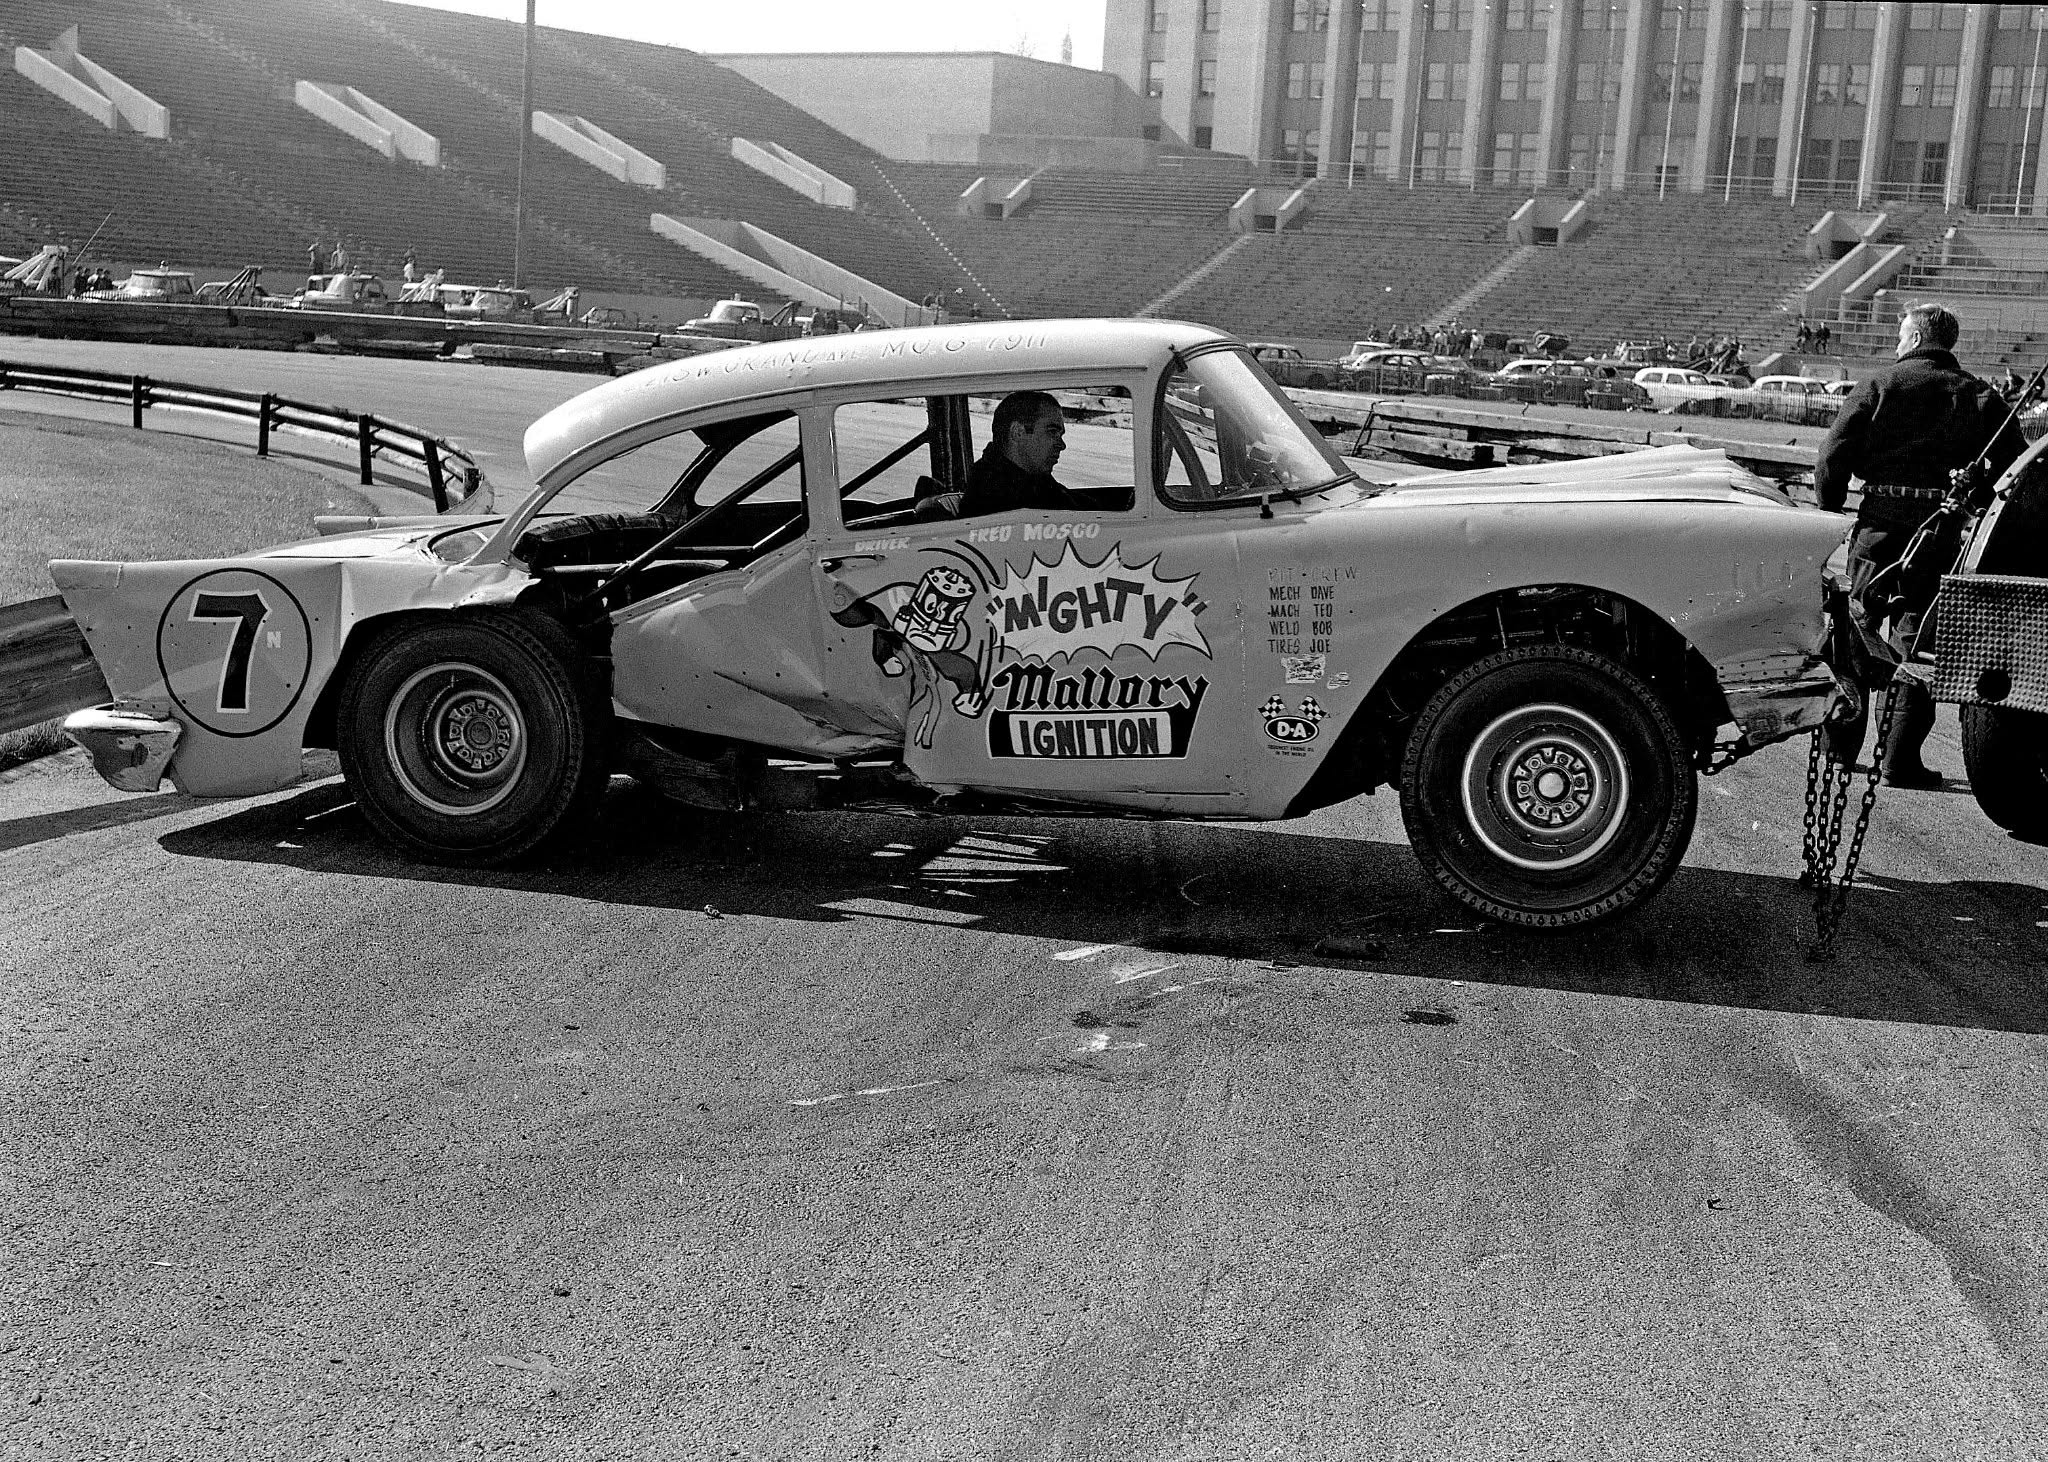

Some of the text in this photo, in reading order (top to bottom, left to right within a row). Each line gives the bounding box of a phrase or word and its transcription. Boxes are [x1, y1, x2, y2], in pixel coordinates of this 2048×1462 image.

[968, 525, 1012, 542] FRED
[1269, 585, 1335, 600] MECH DAVE
[1270, 603, 1333, 618] MACH TED
[1269, 620, 1333, 636] WELD BOB
[266, 631, 282, 648] N
[1268, 638, 1332, 655] TIRES JOE
[188, 589, 273, 713] 7
[991, 661, 1211, 711] Mallory
[1018, 717, 1160, 756] IGNITION
